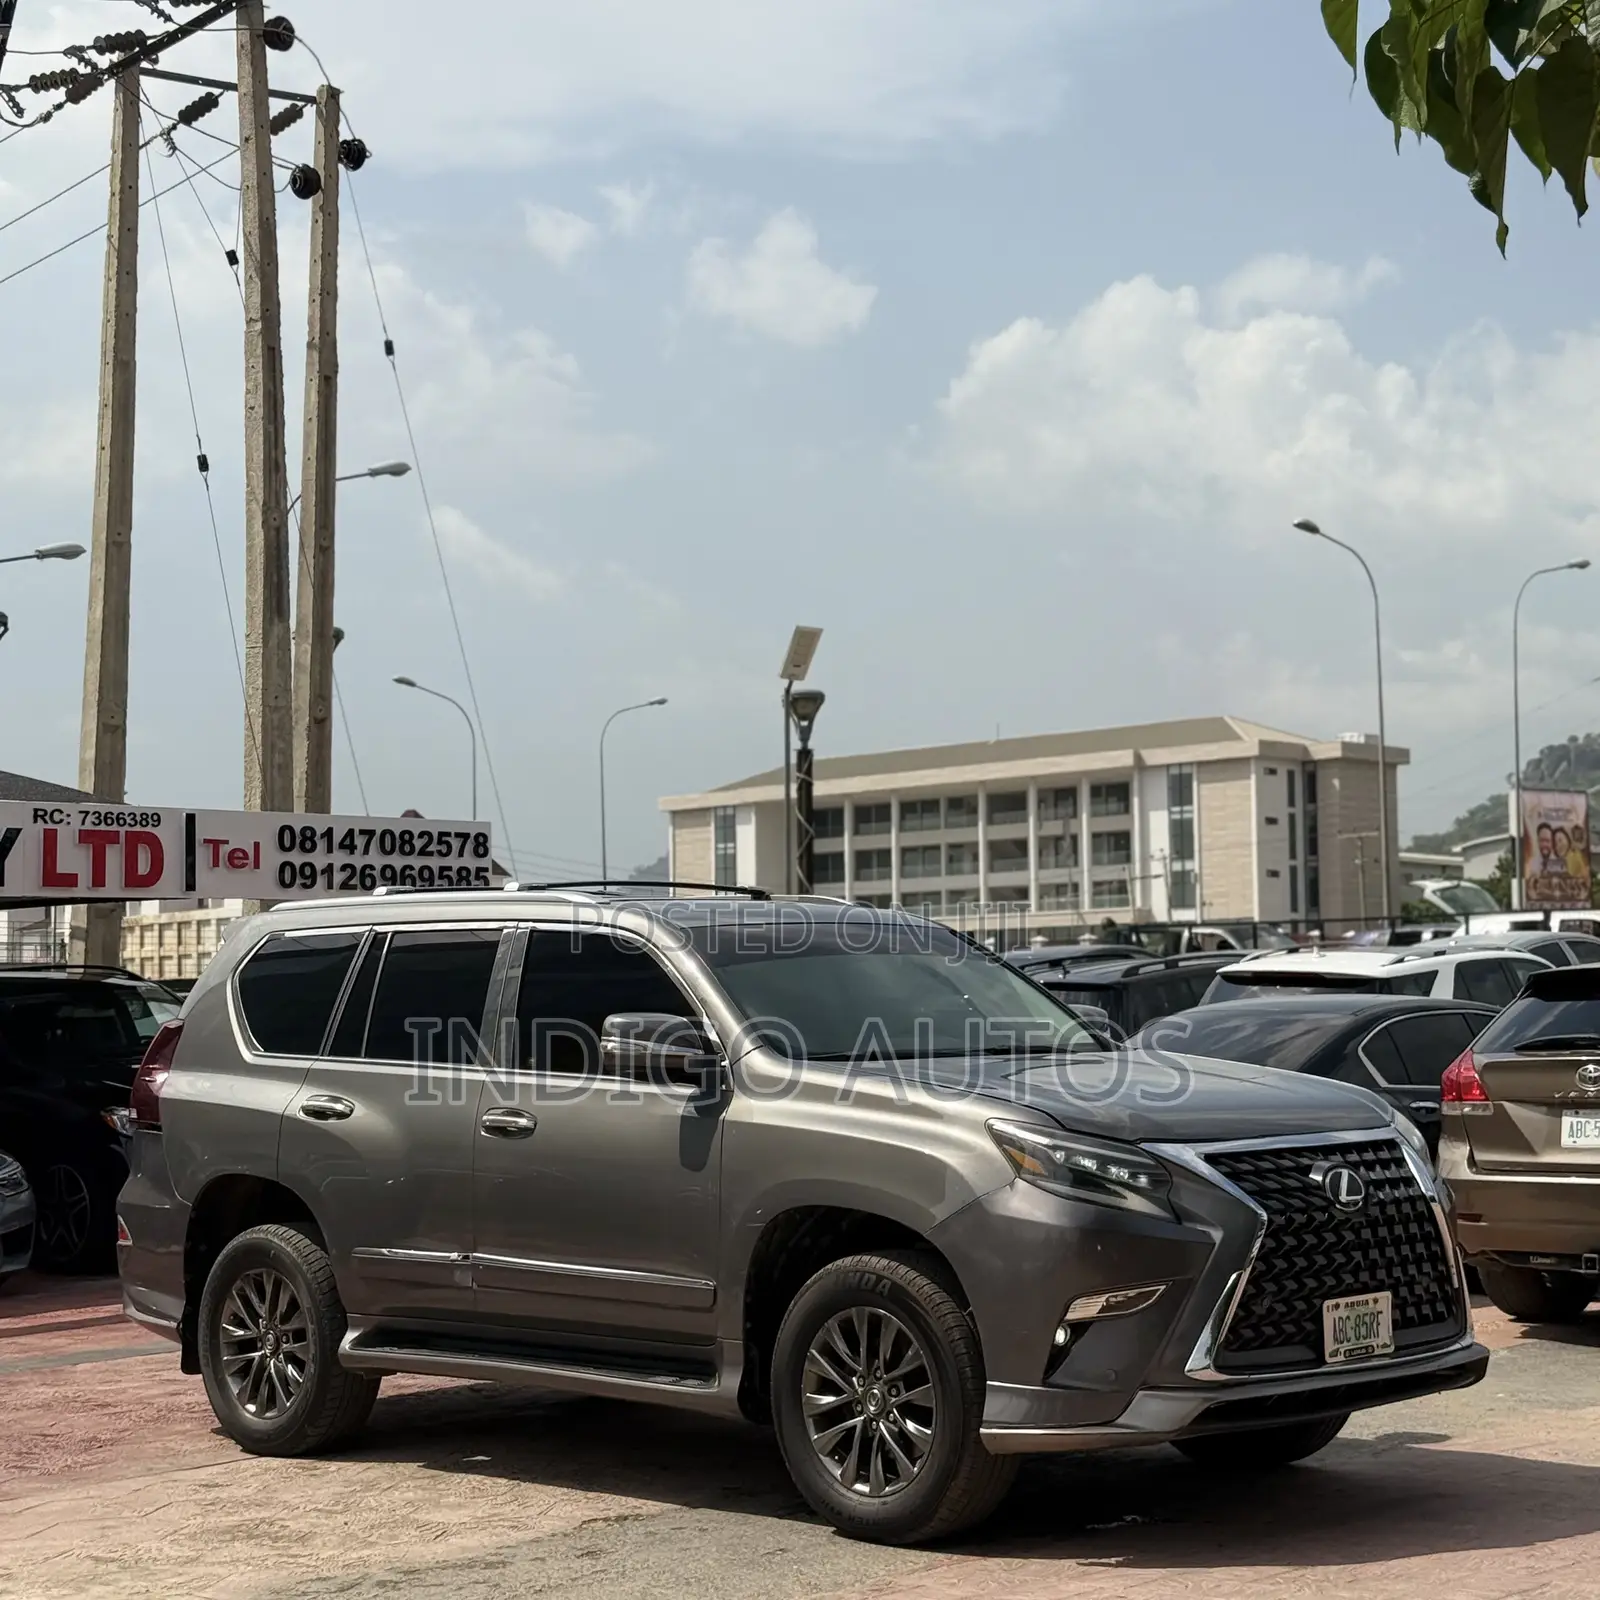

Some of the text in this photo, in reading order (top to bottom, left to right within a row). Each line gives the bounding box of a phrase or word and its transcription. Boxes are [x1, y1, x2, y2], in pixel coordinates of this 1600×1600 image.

[33, 808, 161, 827] RC: 7366389
[203, 838, 260, 870] Tel
[278, 825, 489, 858] 08147082578
[42, 828, 164, 888] LTD
[278, 861, 489, 891] 09126969585
